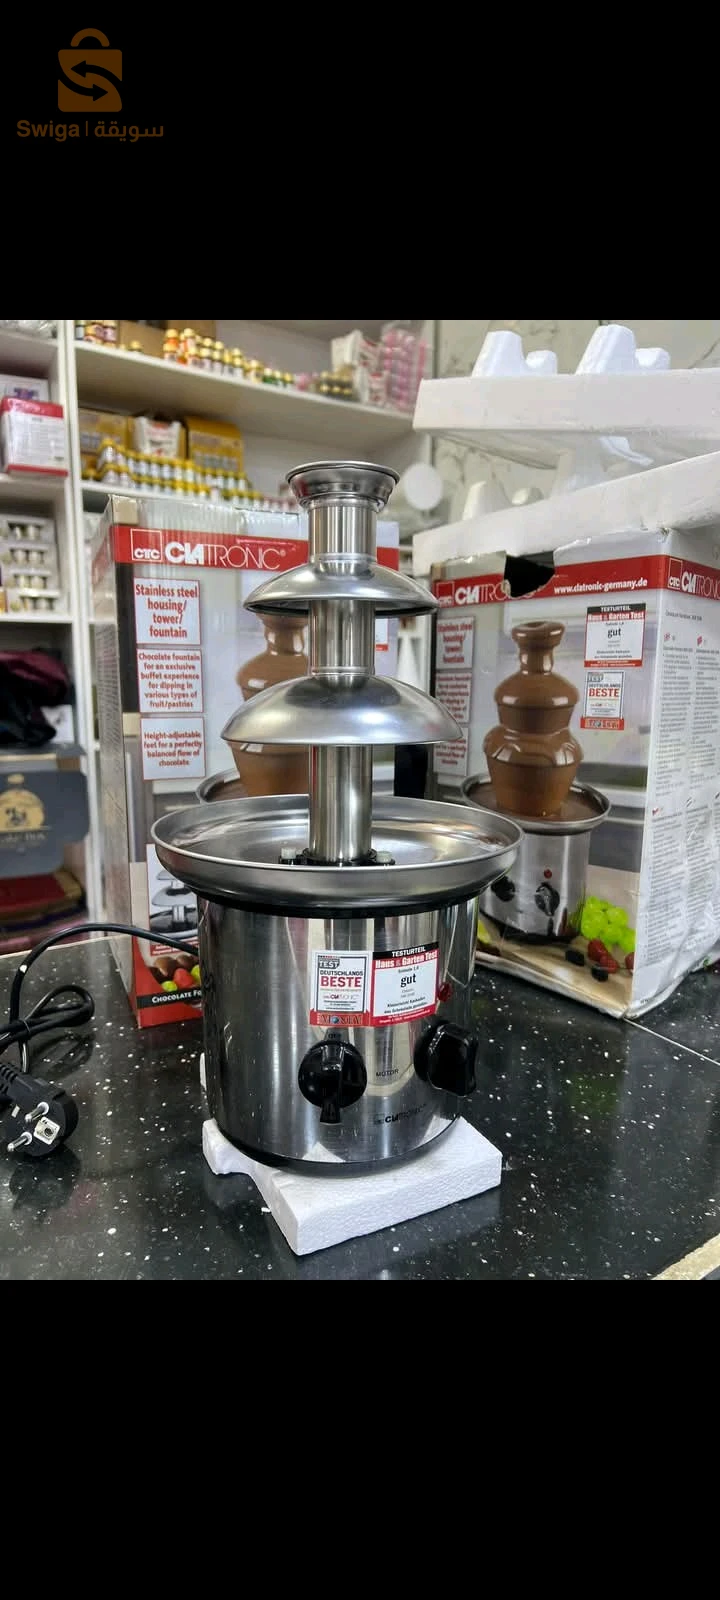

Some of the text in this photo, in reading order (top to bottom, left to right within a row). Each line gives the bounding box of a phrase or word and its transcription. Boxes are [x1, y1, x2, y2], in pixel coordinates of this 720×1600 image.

[134, 548, 160, 560] CTC
[136, 584, 198, 598] Stainless steel
[554, 577, 648, 594] www.clatronic-germany.de
[148, 598, 187, 614] housing/
[153, 613, 183, 625] tower/
[149, 627, 188, 638] fountain
[607, 628, 622, 639] gut
[139, 652, 200, 661] Chocolate fountain
[164, 672, 200, 681] experience
[148, 681, 158, 689] for
[160, 682, 185, 690] dipping
[170, 692, 189, 700] types
[588, 688, 620, 698] BESTE
[149, 701, 193, 709] fruit/pastries
[144, 730, 201, 740] Height-adjustable
[144, 741, 157, 749] feet
[174, 740, 203, 750] perfectly
[147, 750, 177, 758] balanced
[159, 759, 190, 767] chocolate
[391, 946, 426, 957] TESTURTEIL
[375, 959, 395, 969] Haus
[402, 954, 425, 966] Garten
[425, 950, 438, 960] Test
[320, 976, 362, 988] BESTE
[400, 973, 417, 988] gut
